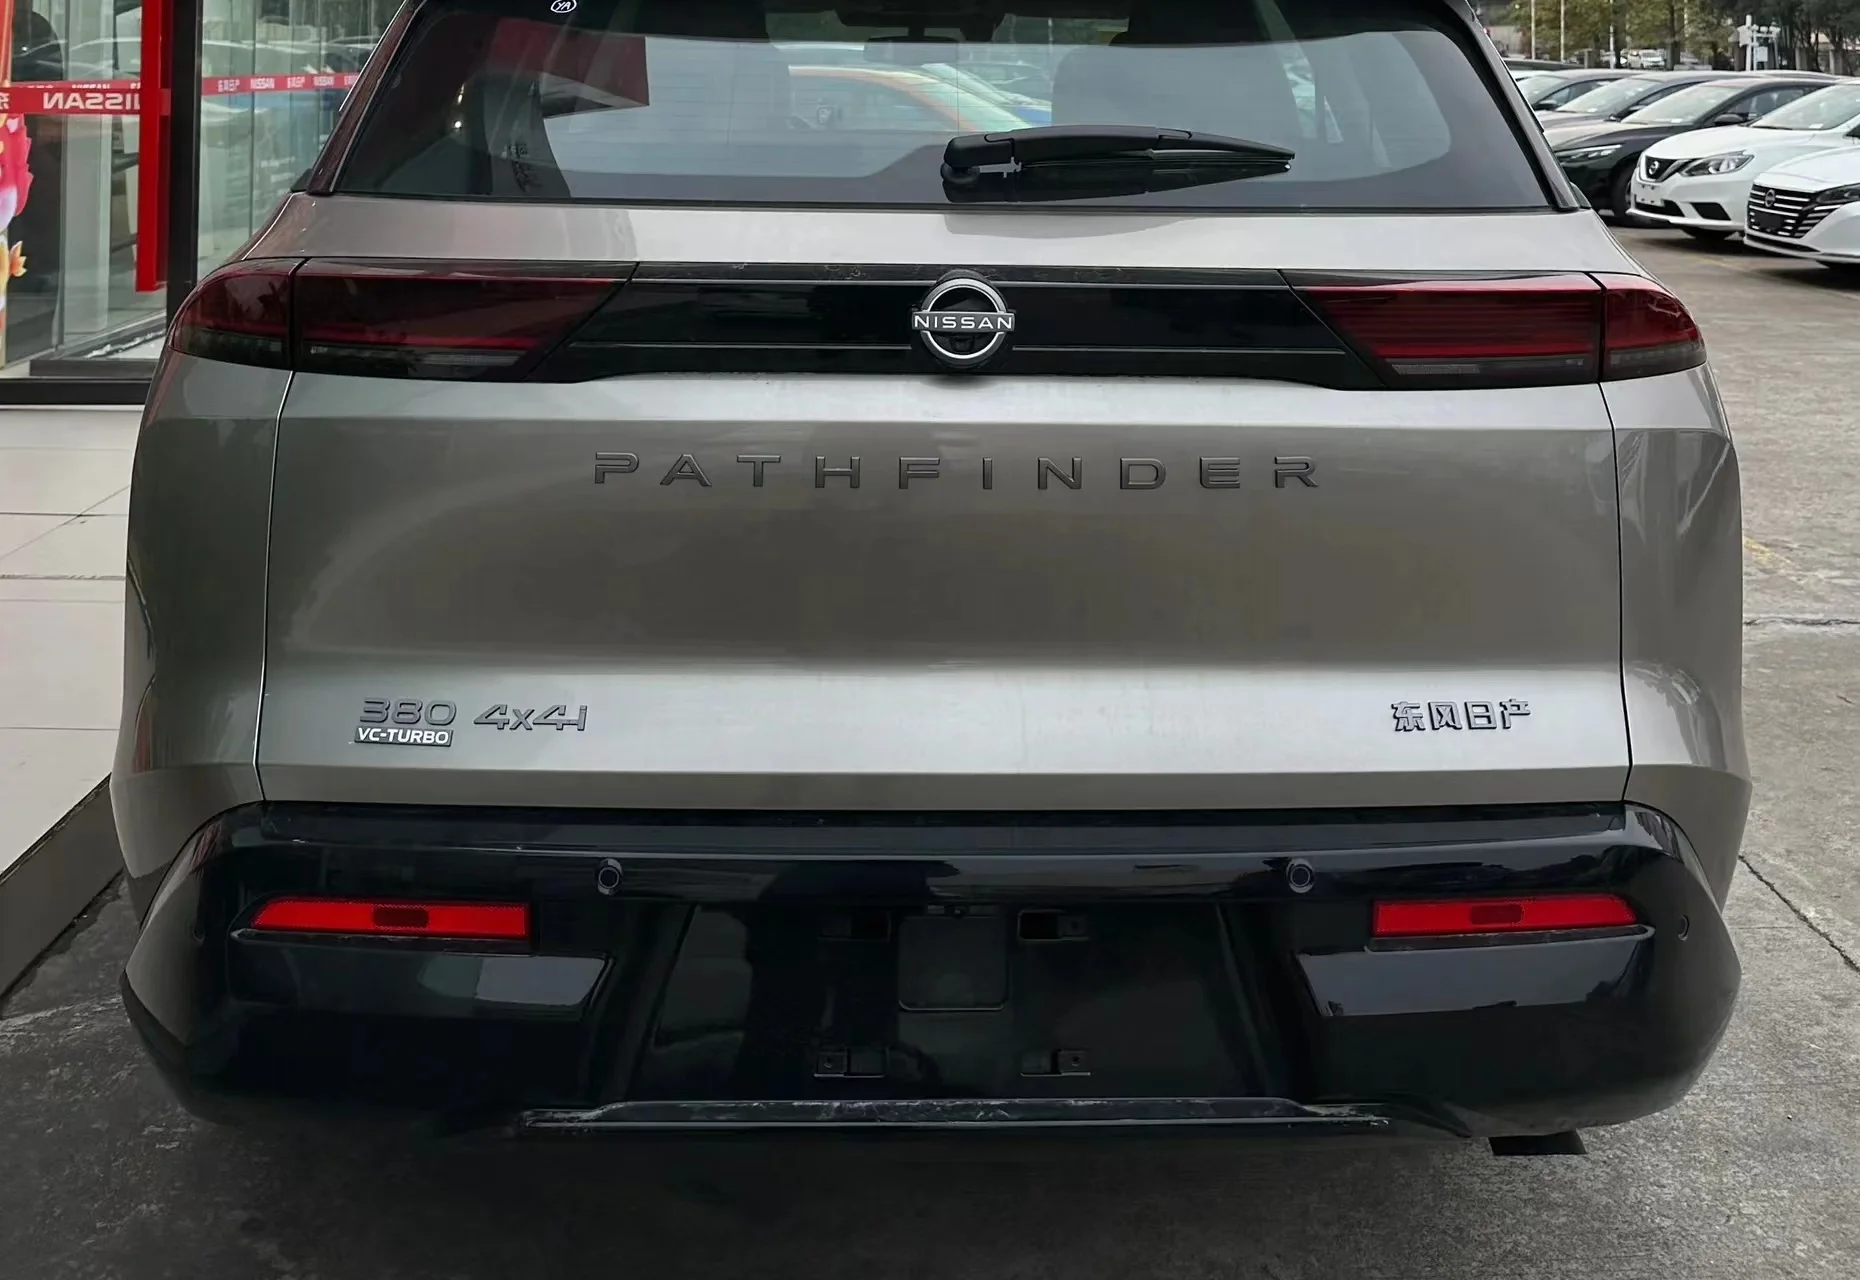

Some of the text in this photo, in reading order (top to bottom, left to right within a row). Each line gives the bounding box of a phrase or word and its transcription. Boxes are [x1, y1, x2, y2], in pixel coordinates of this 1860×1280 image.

[914, 315, 1012, 330] NISSAN
[594, 452, 1319, 490] PATHFINDER
[359, 697, 457, 726] 380
[1391, 698, 1531, 732] 东风日产
[357, 727, 450, 745] VC-TURBO
